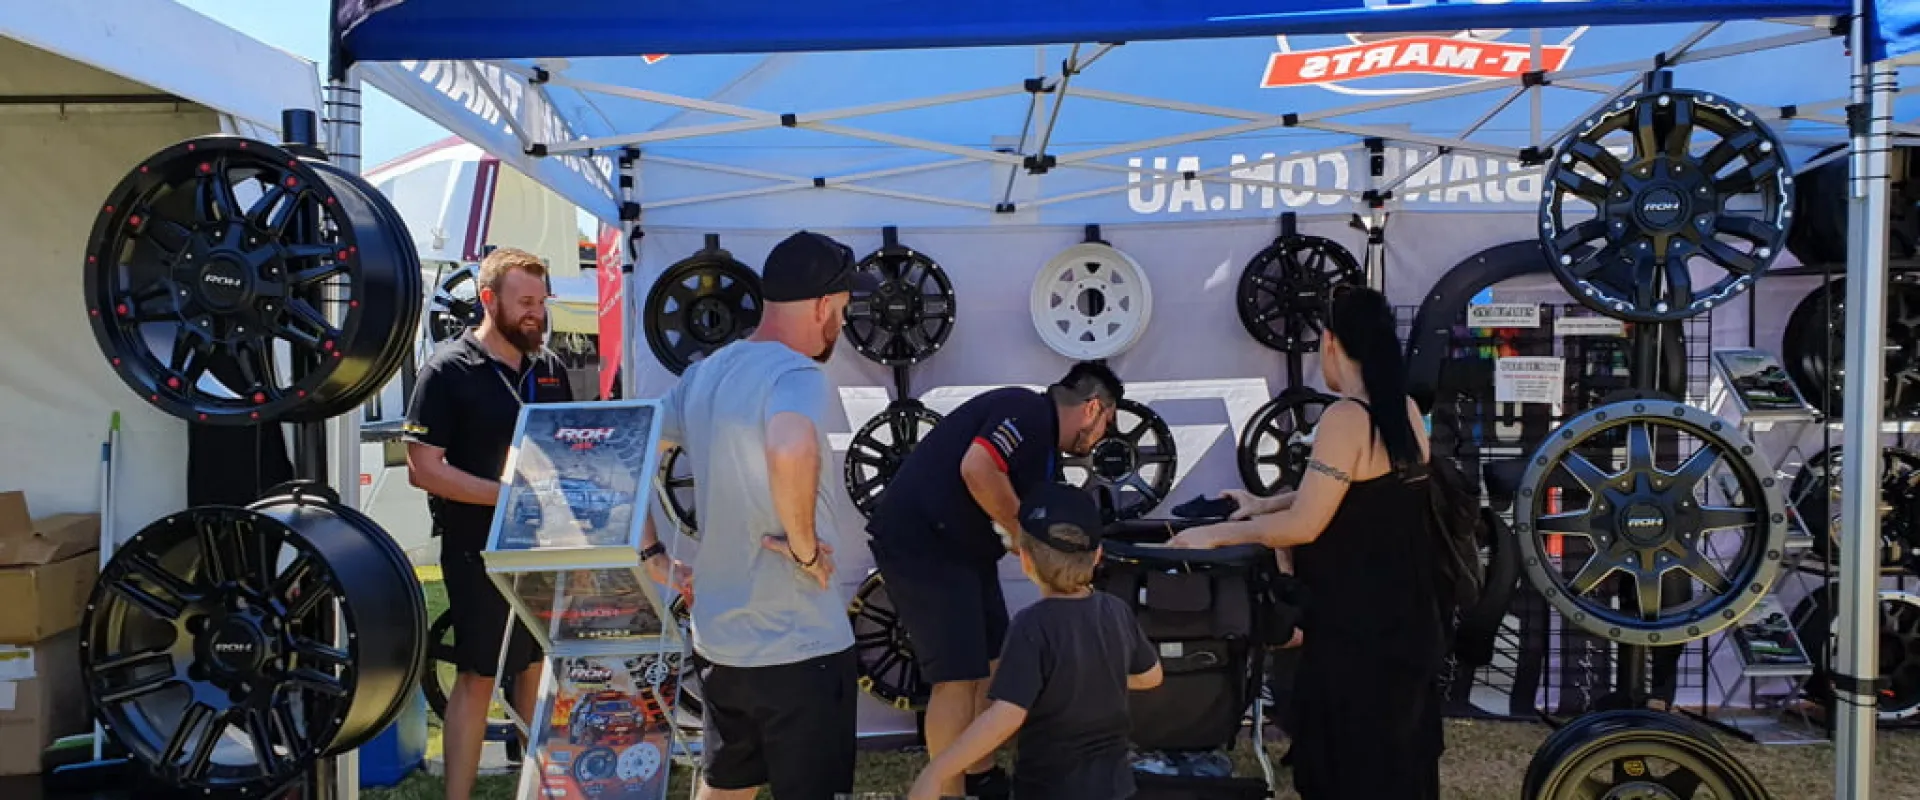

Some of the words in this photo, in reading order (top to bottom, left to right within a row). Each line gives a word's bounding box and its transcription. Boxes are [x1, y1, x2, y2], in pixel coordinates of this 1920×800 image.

[205, 274, 241, 286] ROH
[555, 427, 616, 440] ROH
[1628, 518, 1664, 527] ROH
[215, 643, 252, 652] ROH
